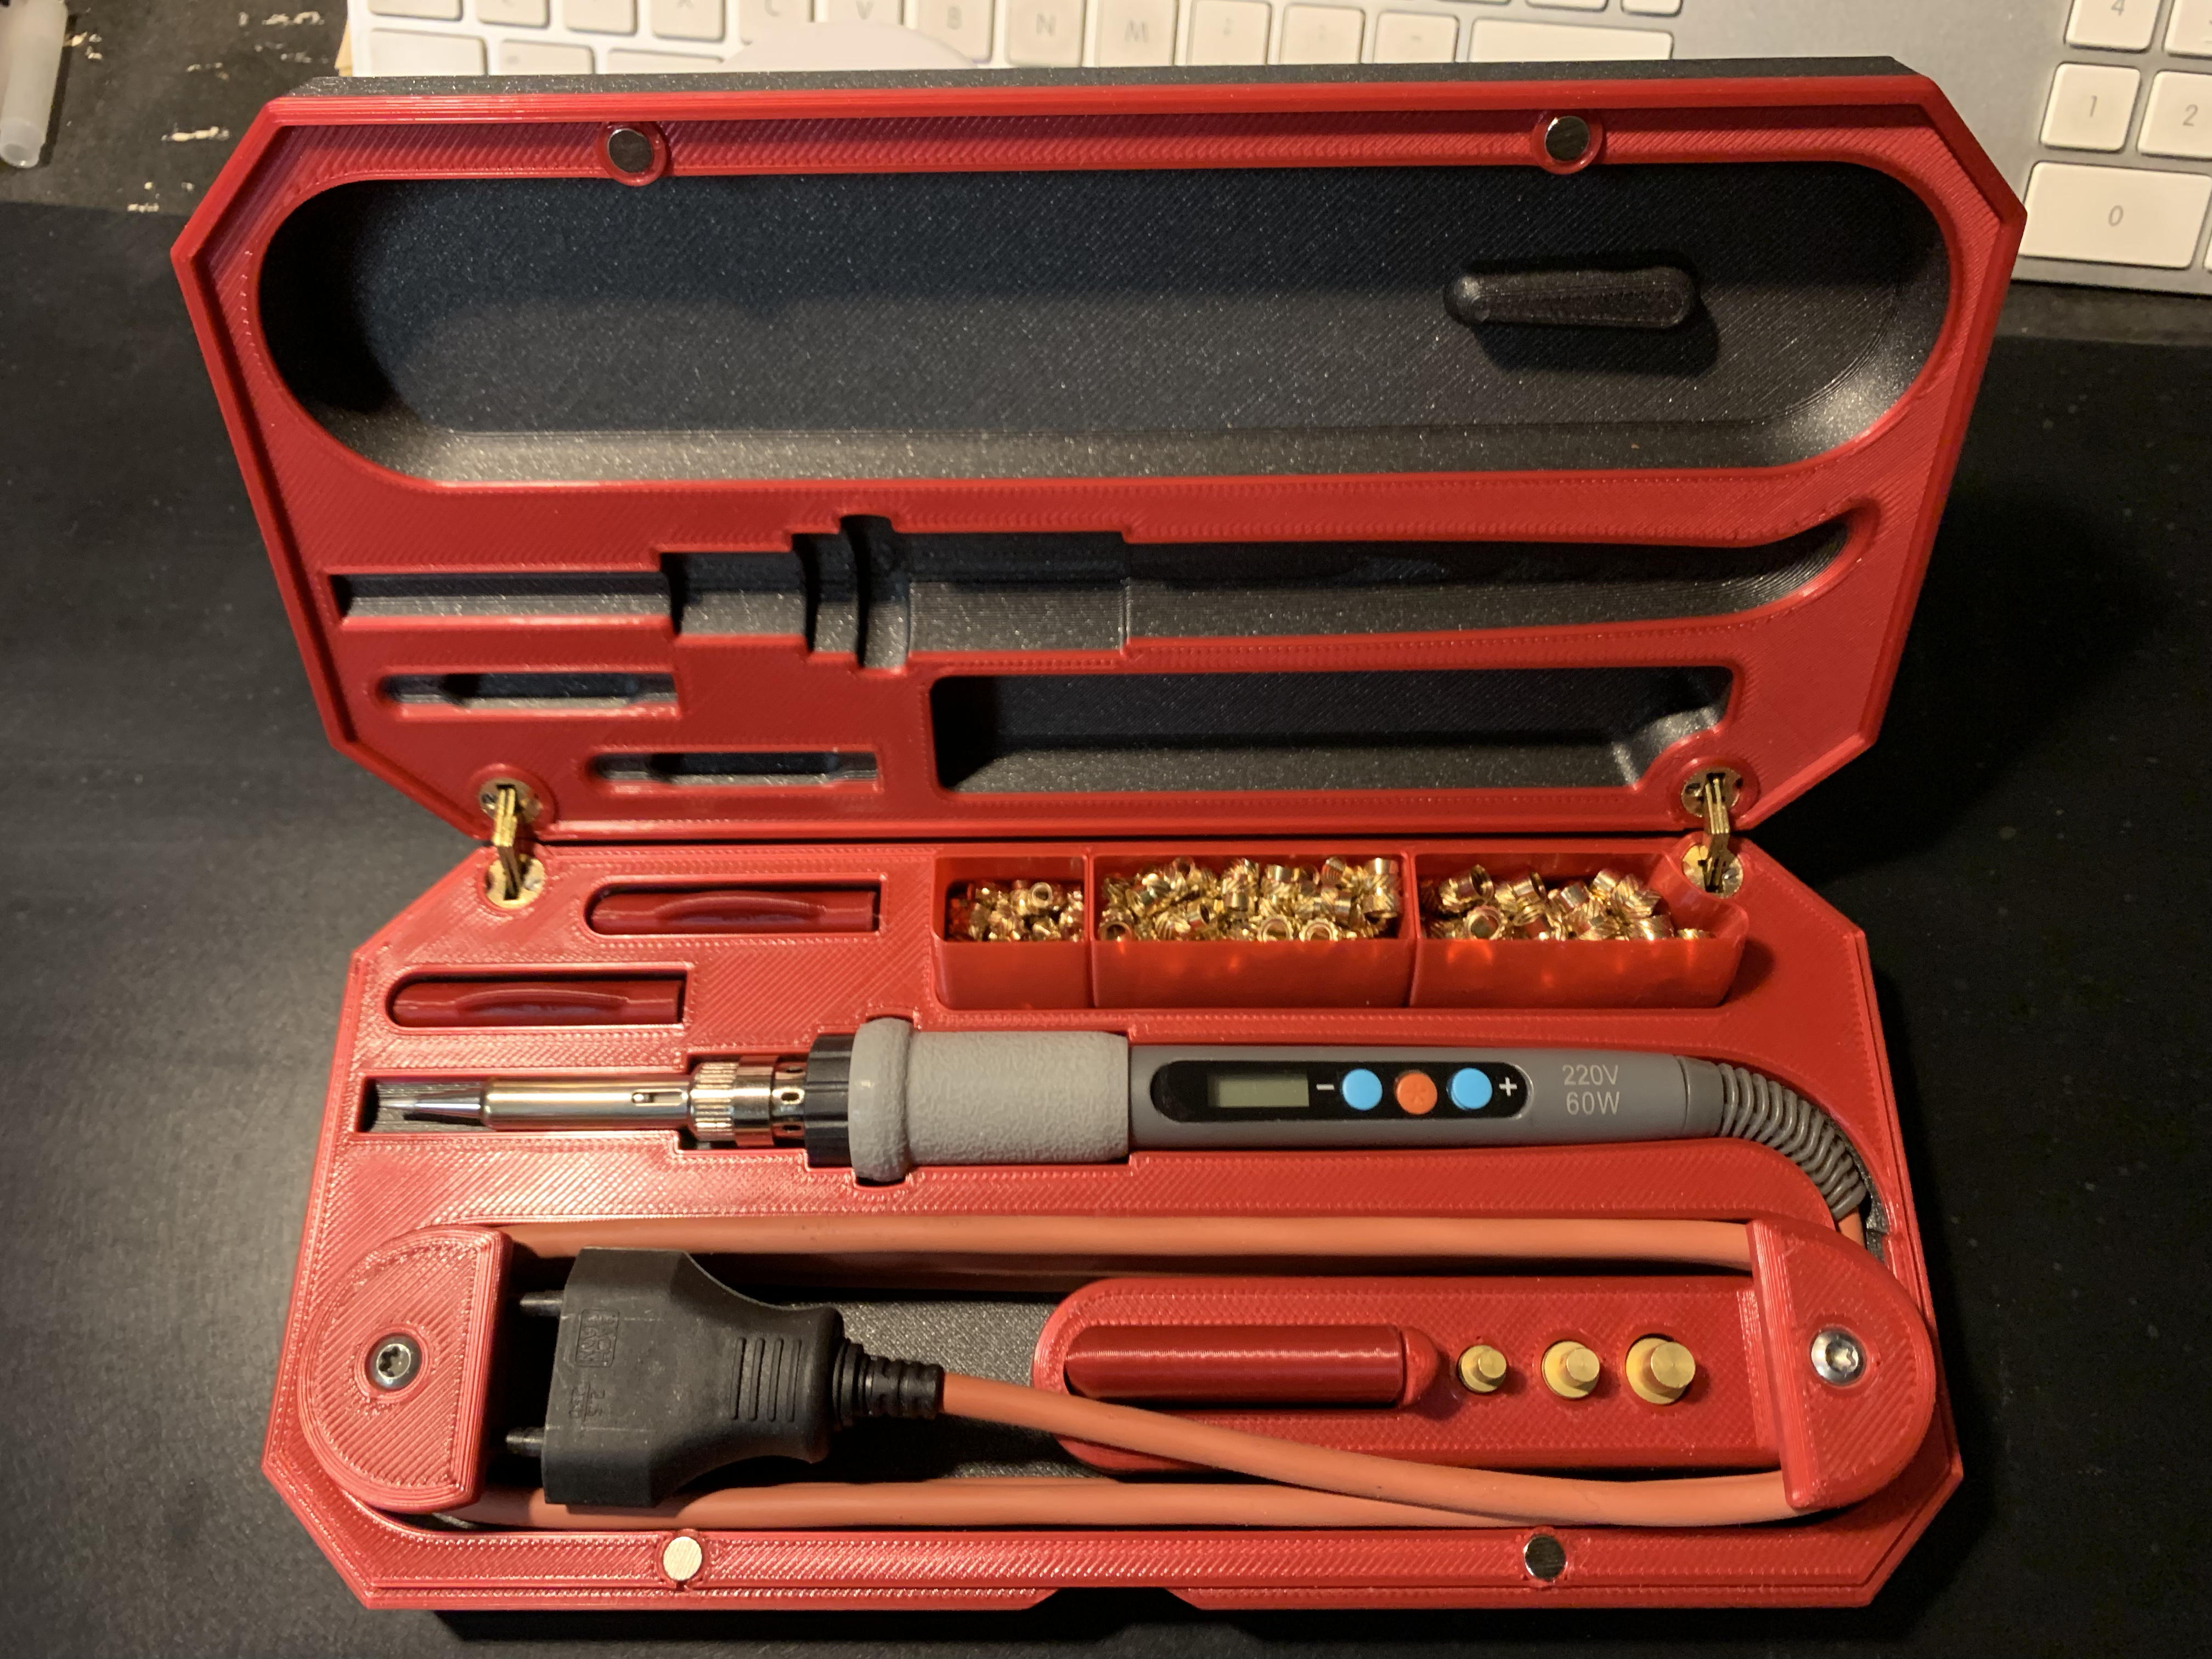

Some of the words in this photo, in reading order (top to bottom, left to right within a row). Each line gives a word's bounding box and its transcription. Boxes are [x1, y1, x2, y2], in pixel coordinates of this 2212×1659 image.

[2111, 0, 2126, 16] 4
[1036, 12, 1057, 37] N
[1124, 20, 1150, 43] M
[2090, 95, 2098, 117] 1
[2182, 104, 2199, 127] 2
[2108, 205, 2124, 227] 0
[1562, 1064, 1618, 1086] 220V
[1566, 1091, 1620, 1115] 60W
